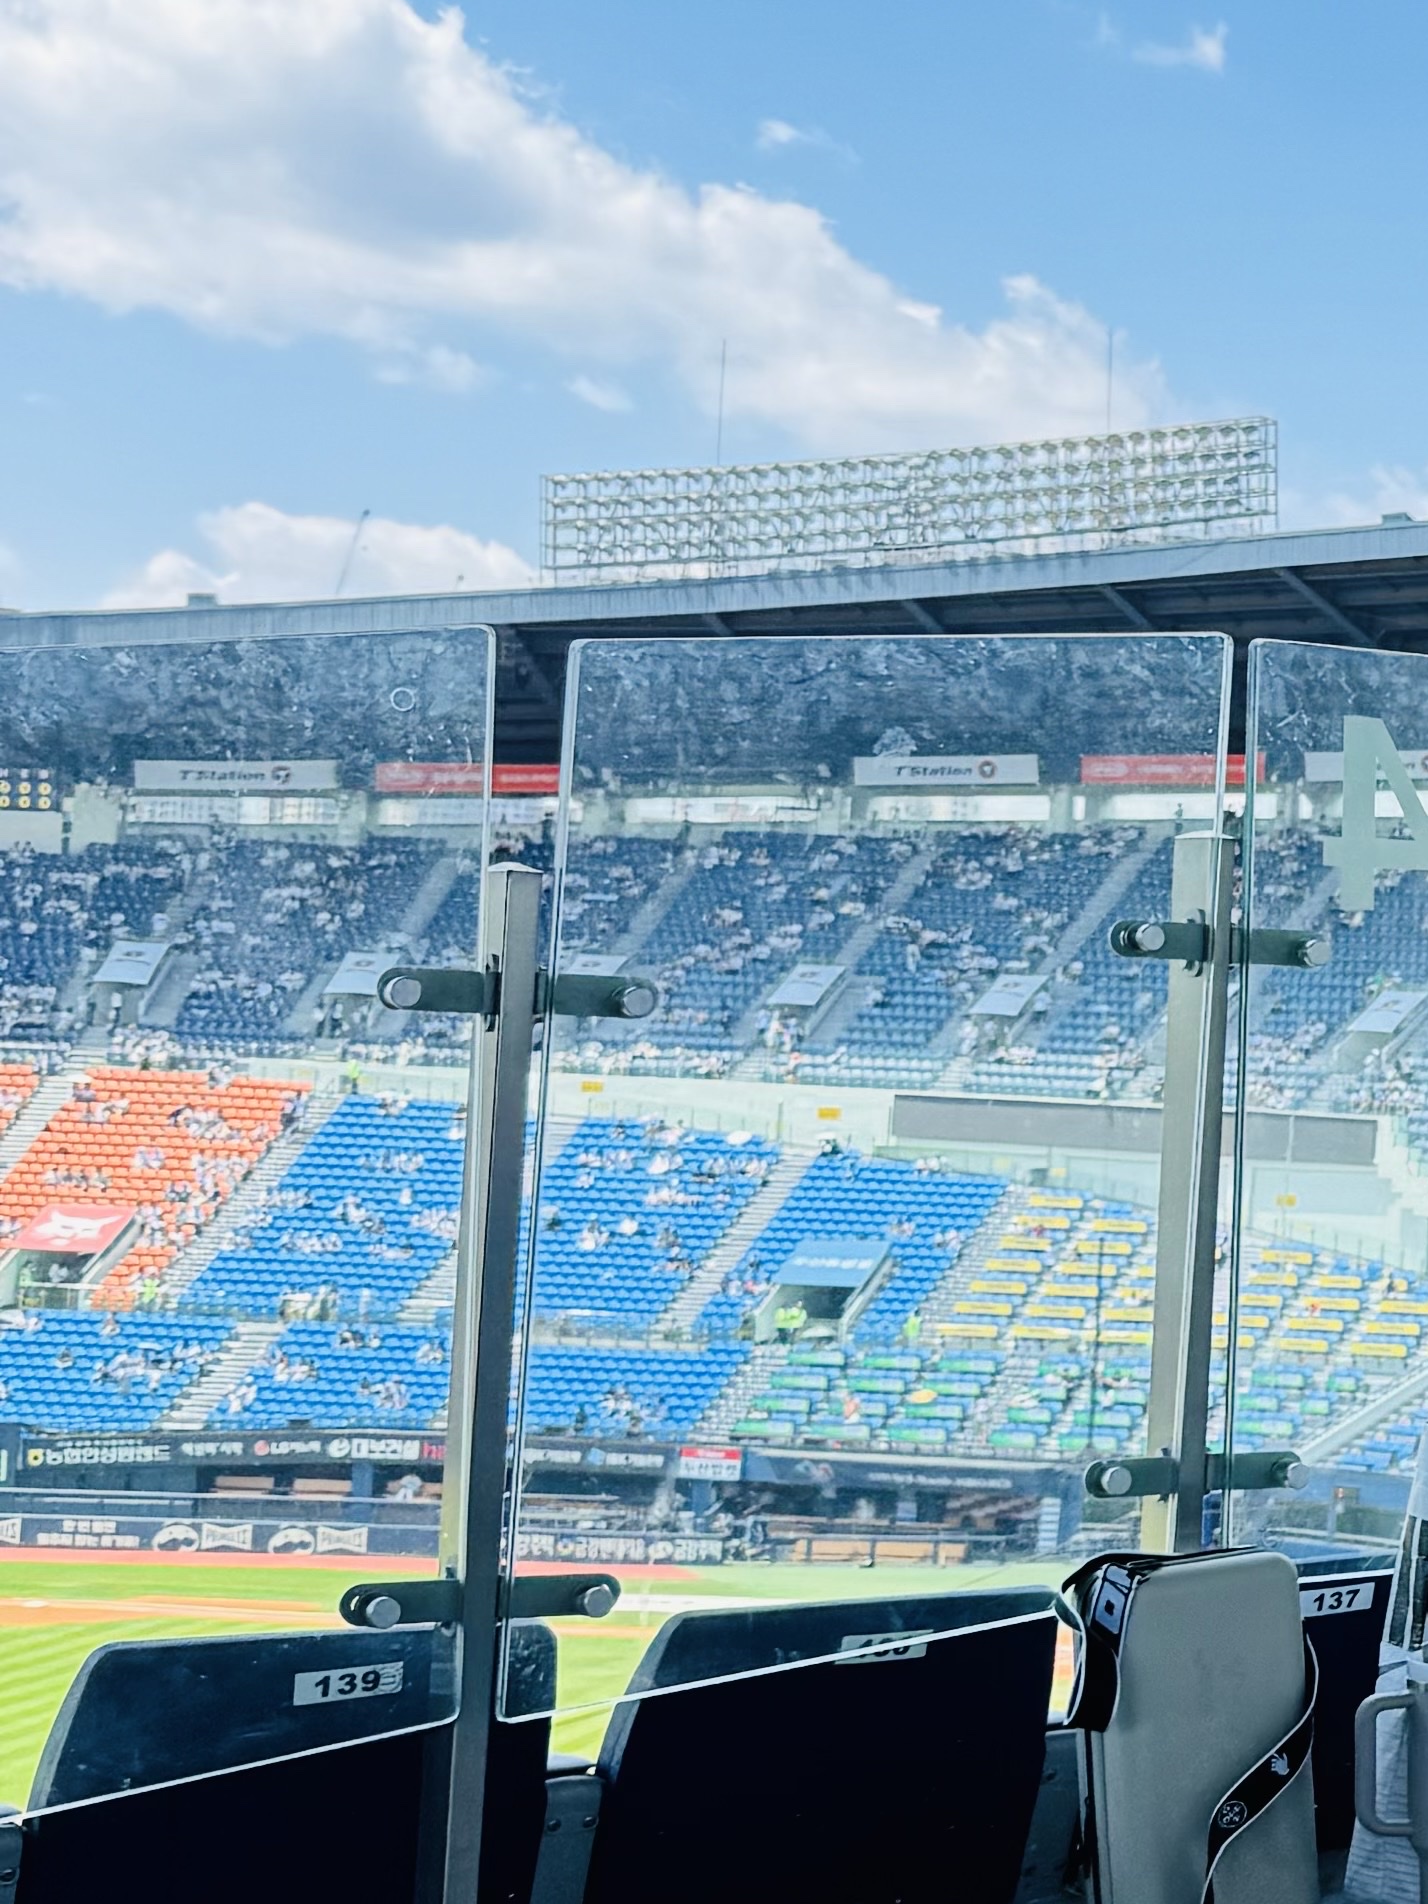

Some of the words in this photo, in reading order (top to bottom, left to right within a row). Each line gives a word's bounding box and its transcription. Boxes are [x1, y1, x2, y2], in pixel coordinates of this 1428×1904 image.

[192, 768, 266, 782] Station
[351, 1438, 421, 1461] 대보건설
[1312, 1588, 1361, 1612] 137
[314, 1669, 381, 1698] 139
